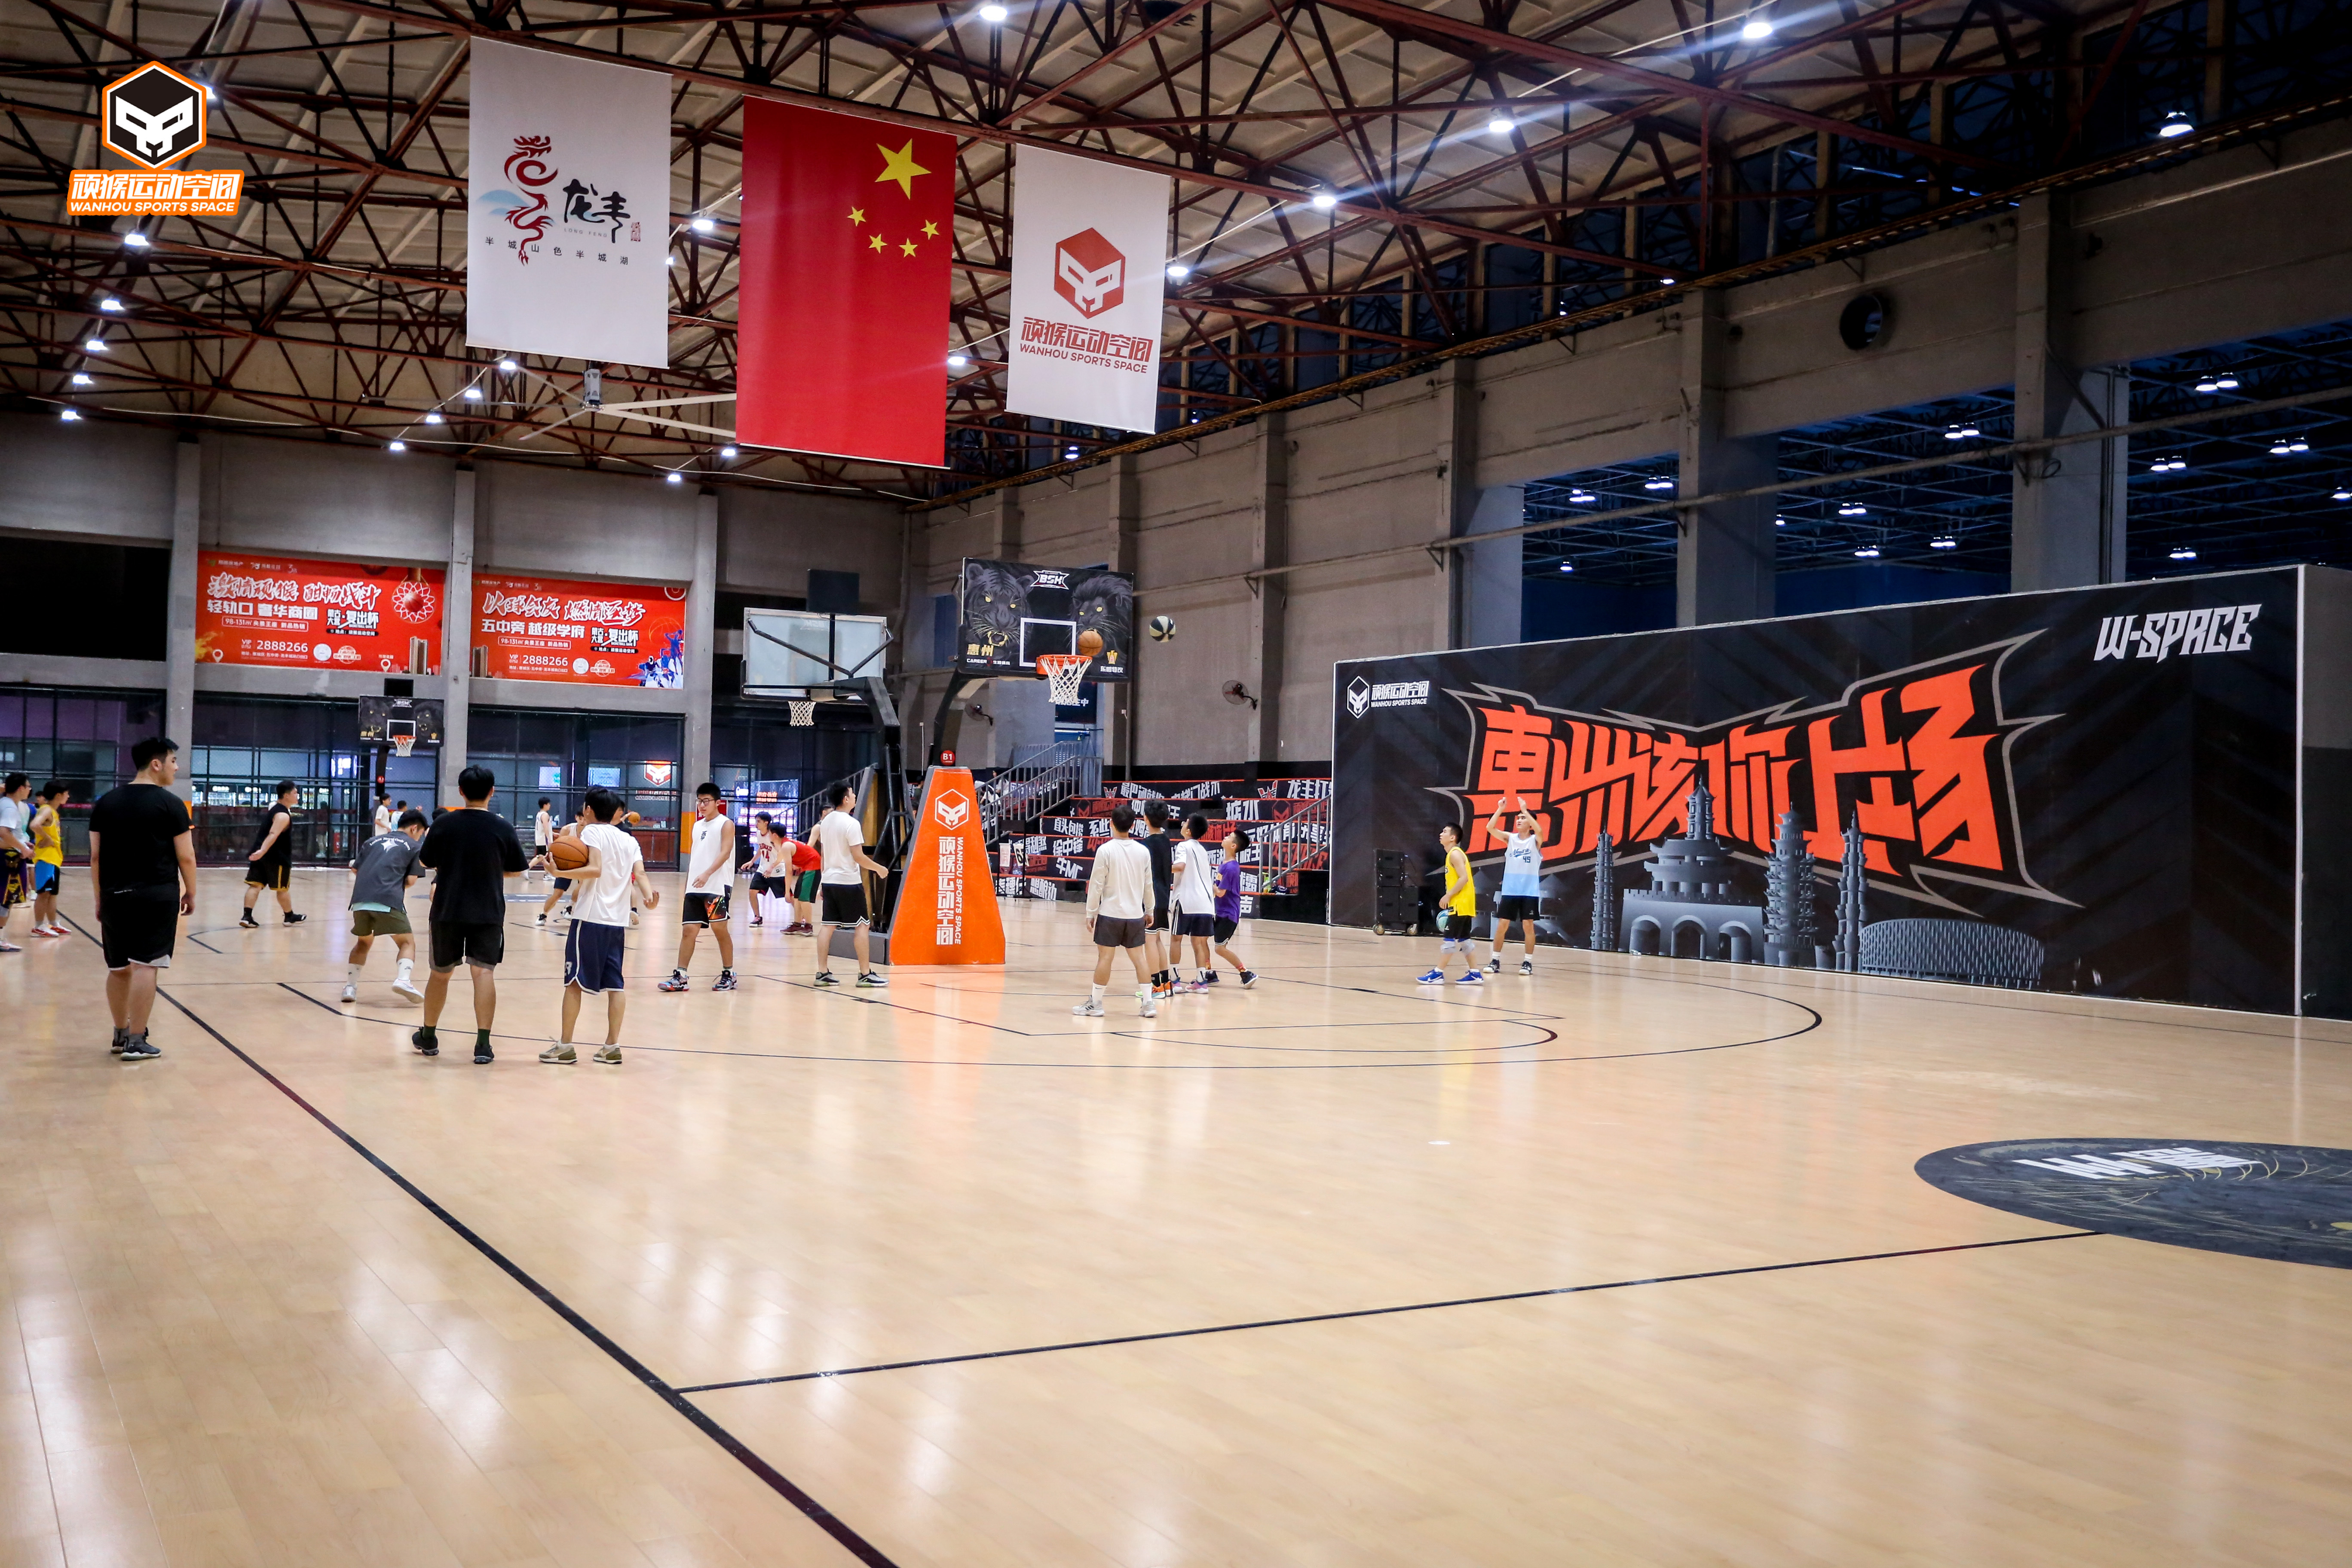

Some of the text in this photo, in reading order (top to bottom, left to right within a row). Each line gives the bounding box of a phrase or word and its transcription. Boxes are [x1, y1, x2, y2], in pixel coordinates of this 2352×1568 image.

[485, 236, 628, 265] 半城山色半城湖
[1021, 316, 1153, 362] 顽猴运动空间
[1020, 343, 1148, 374] WANHOU SPORTS SPACE
[207, 599, 318, 620] 轻轨口 奢华商圈
[564, 599, 646, 627] 燃情逐梦
[481, 619, 585, 638] 五中旁 越级学府
[2093, 604, 2262, 663] W-SPACE
[257, 640, 308, 652] 2888266
[967, 643, 994, 657] 惠州
[523, 655, 568, 666] 2888266
[1371, 680, 1430, 701] 顽猴运动空间
[936, 836, 956, 946] 顽猴运动空间
